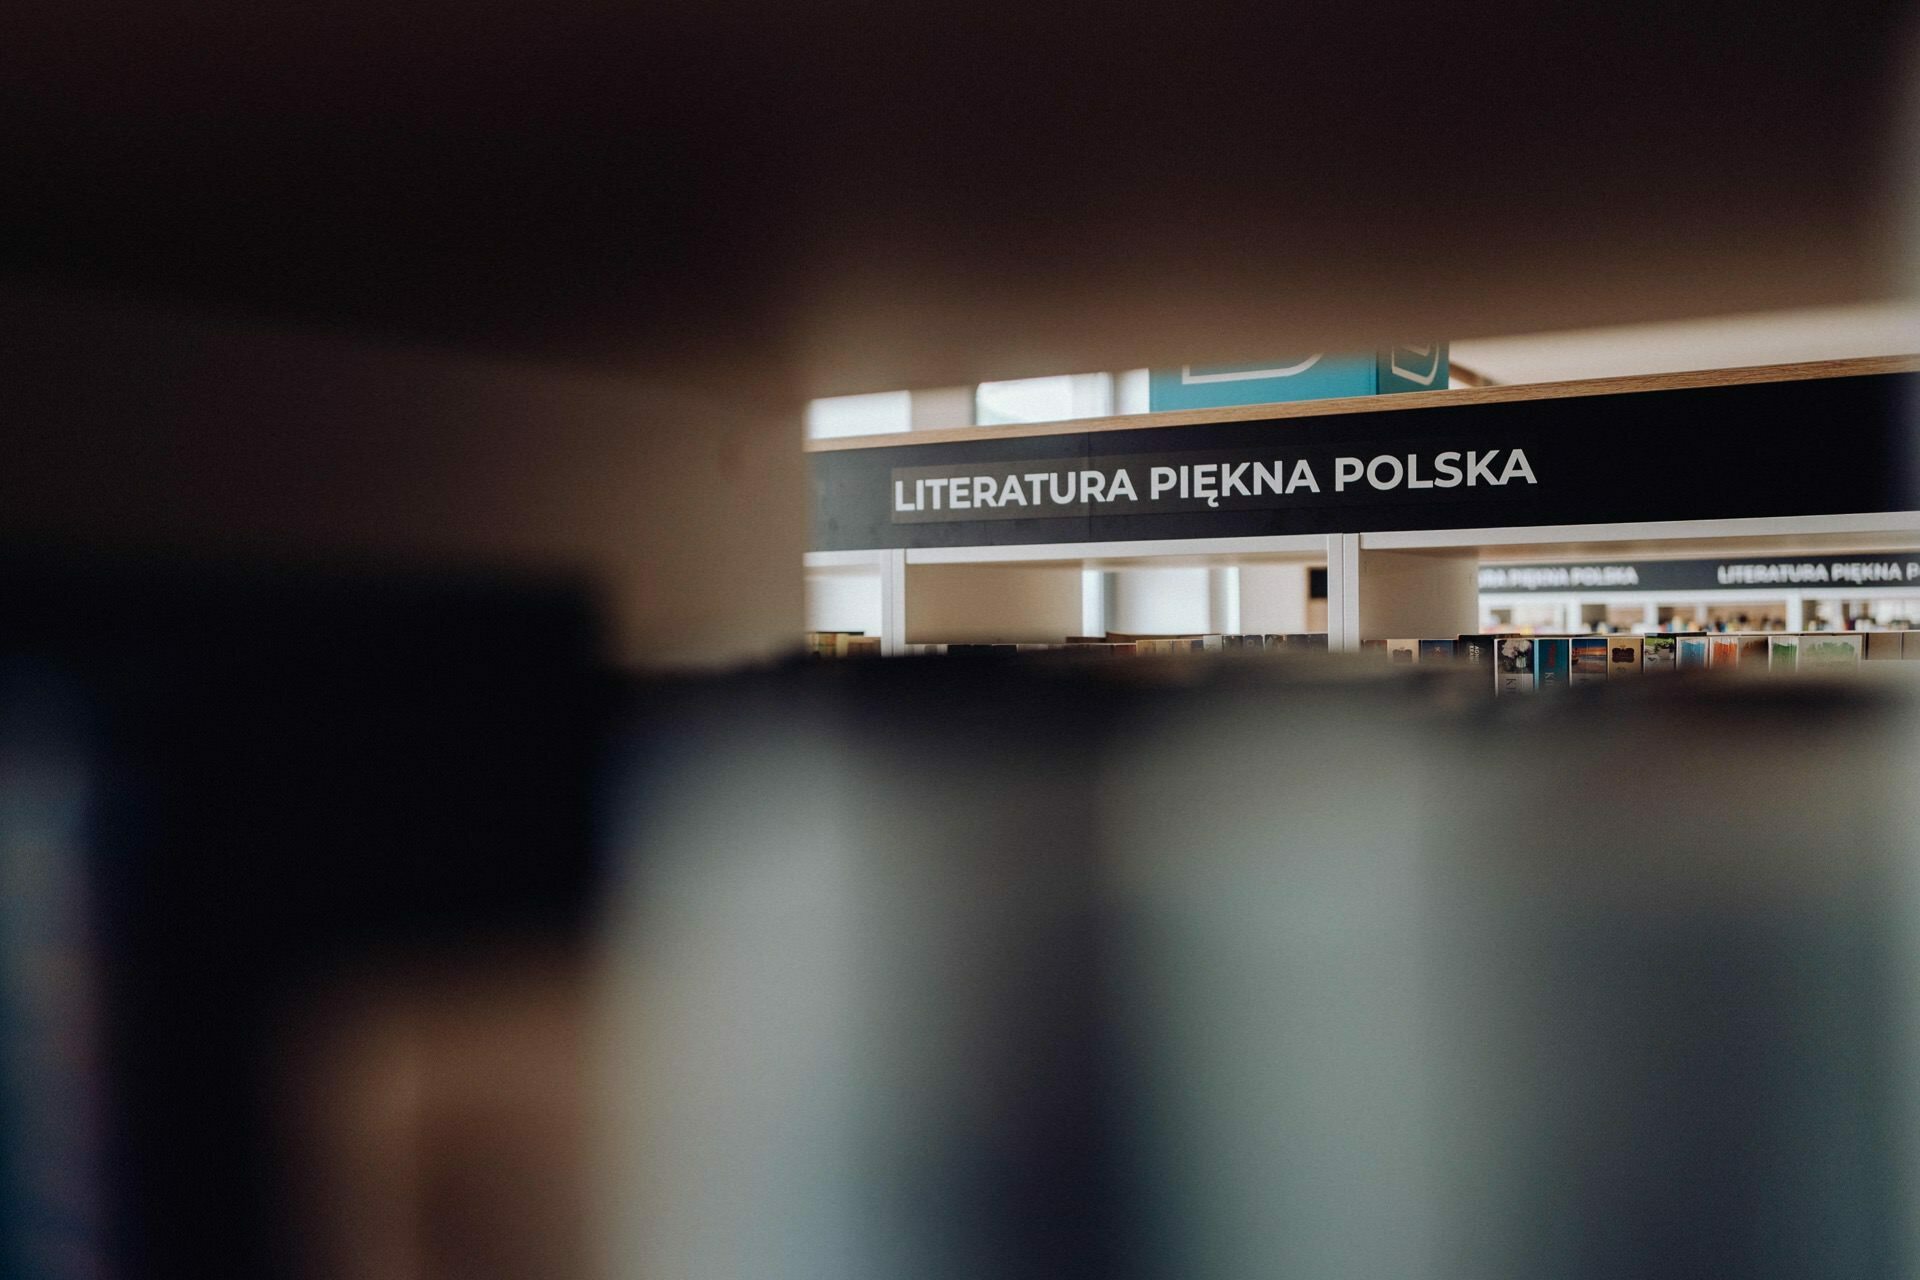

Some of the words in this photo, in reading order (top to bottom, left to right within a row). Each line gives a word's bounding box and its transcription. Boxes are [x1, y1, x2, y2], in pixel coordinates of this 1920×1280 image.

[892, 469, 1139, 512] LITERATURA
[1150, 458, 1321, 508] PIĘKNA
[1335, 448, 1538, 491] POLSKA
[1570, 566, 1639, 587] POLSKA
[1717, 564, 1829, 584] LITERATURA
[1831, 562, 1902, 584] PIĘKNA
